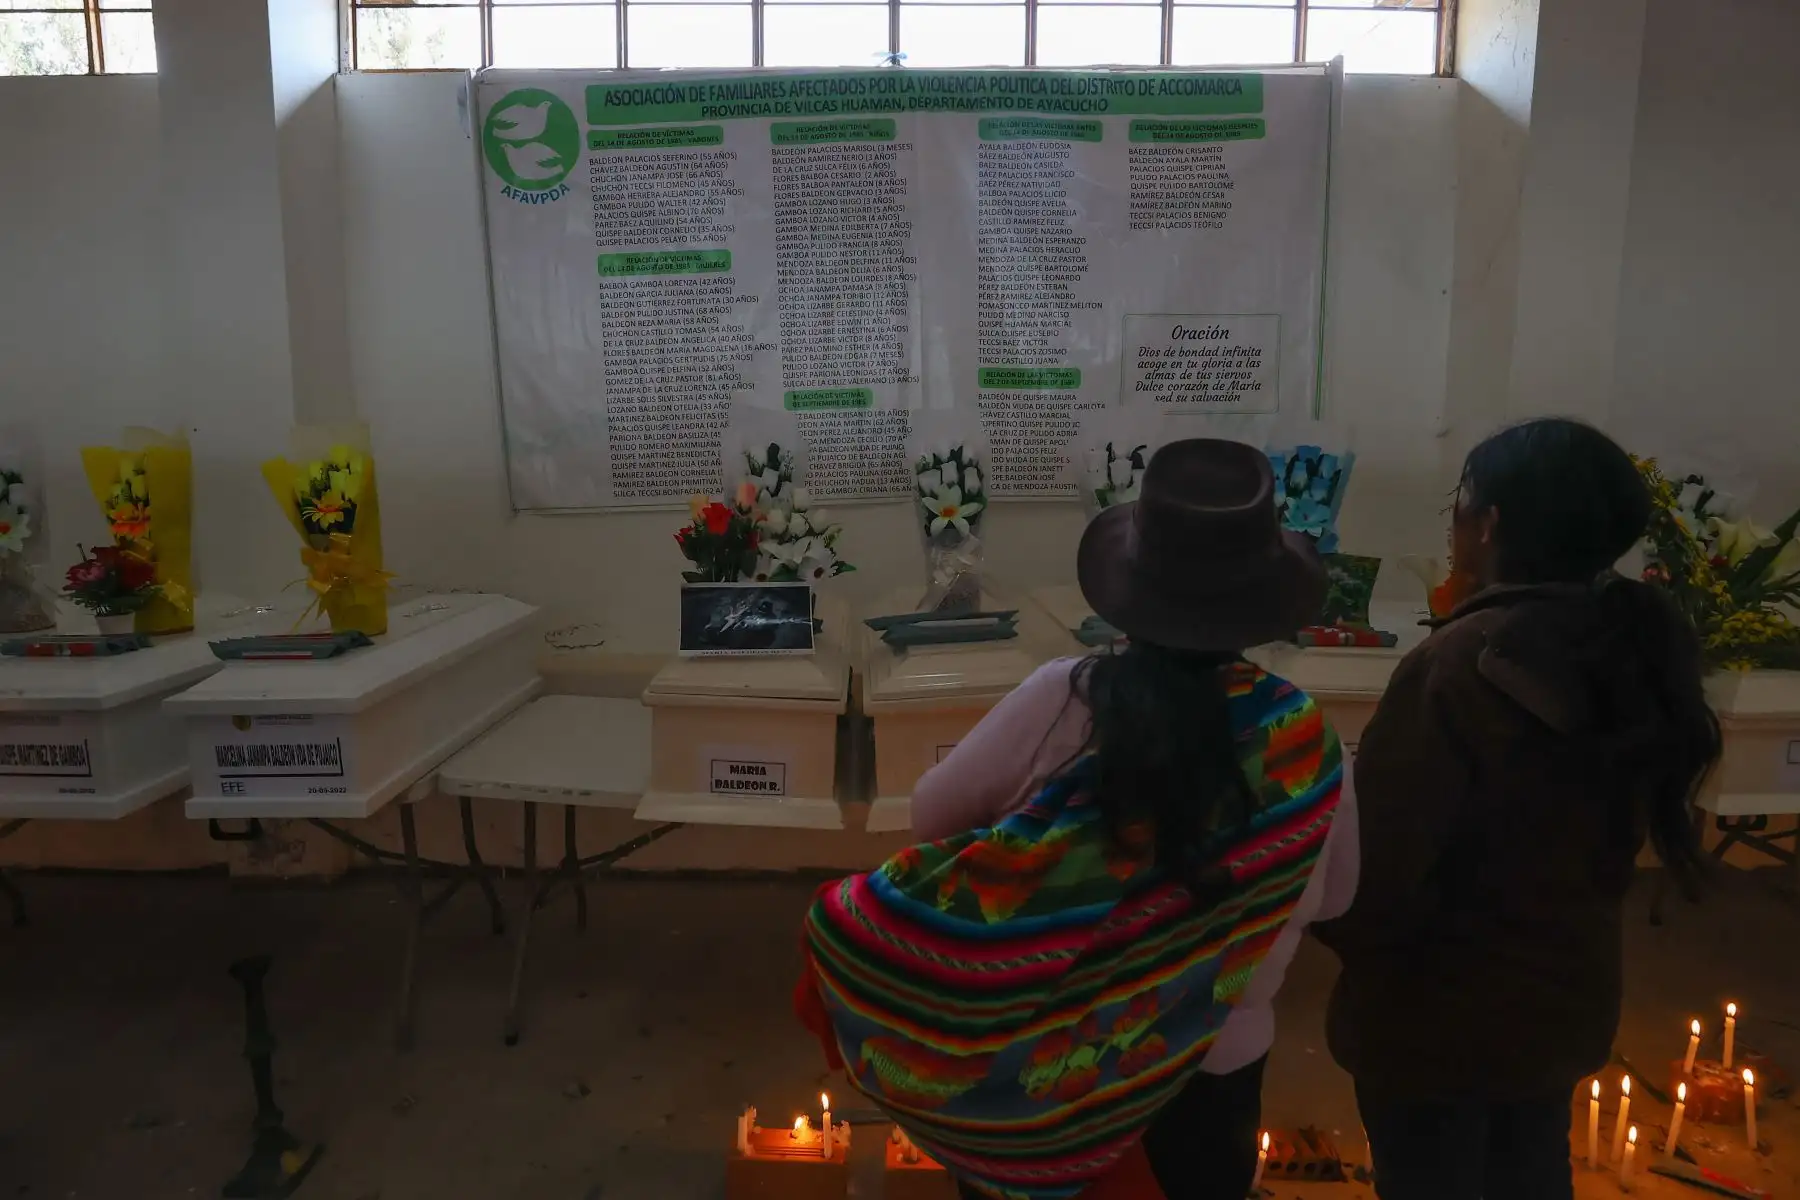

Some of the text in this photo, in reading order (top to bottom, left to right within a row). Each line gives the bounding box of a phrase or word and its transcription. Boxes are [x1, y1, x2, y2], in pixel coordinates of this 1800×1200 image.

[604, 82, 686, 107] ASOCIACIÓN
[689, 85, 706, 103] DE
[710, 80, 786, 102] FAMILIARES
[789, 77, 866, 98] AFECTADOS
[869, 77, 896, 94] POR
[900, 76, 916, 93] LA
[918, 75, 986, 93] VIOLENCIA
[1051, 78, 1074, 96] DEL
[1077, 77, 1135, 96] DISTRITO
[1139, 78, 1155, 96] DE
[1158, 78, 1243, 96] ACCOMARCA
[701, 102, 772, 118] PROVINCIA
[774, 101, 791, 114] DE
[794, 99, 837, 113] VILCAS
[909, 96, 1014, 109] DEPARTAMENTO
[1017, 97, 1033, 109] DE
[1037, 98, 1108, 112] AYACUCHO
[807, 146, 842, 155] PALACIOS
[843, 145, 876, 153] MARISOL
[1185, 147, 1223, 155] CRISANTO
[625, 155, 661, 164] PALACIOS
[662, 154, 698, 163] SEFERINO
[1159, 173, 1196, 181] PALACIOS
[1197, 172, 1229, 180] PAULINA
[656, 181, 696, 190] FILOMENO
[500, 183, 571, 205] AFAVPDA
[592, 193, 625, 202] GAMBOA
[627, 192, 661, 201] HERRERA
[662, 190, 705, 199] ALEJANDRO
[1014, 208, 1040, 216] QUISPE
[1041, 209, 1077, 217] CORNELIA
[1156, 211, 1191, 219] PALACIOS
[1193, 211, 1227, 219] BENIGNO
[978, 227, 1012, 235] GAMBOA
[1013, 227, 1039, 235] QUISPE
[596, 238, 623, 247] QUISPE
[624, 237, 659, 246] PALACIOS
[661, 236, 688, 245] PELAYO
[1016, 255, 1027, 263] DE
[1028, 255, 1037, 263] LA
[1038, 255, 1058, 263] CRUZ
[677, 297, 721, 307] FORTUNATA
[1171, 324, 1231, 341] Oración
[1138, 345, 1262, 359] Dios de bondad infinita
[1137, 357, 1262, 371] acoge en tu gloria a las
[1144, 369, 1252, 380] almas de tus siervos
[663, 385, 683, 393] CRUZ
[684, 384, 717, 393] LORENZA
[1135, 380, 1262, 392] Dulce corazón de María
[1012, 393, 1022, 401] DE
[1153, 391, 1241, 403] sed su salvación
[728, 764, 767, 777] MARIA
[220, 781, 247, 793] EFE
[714, 778, 767, 792] BALDEON
